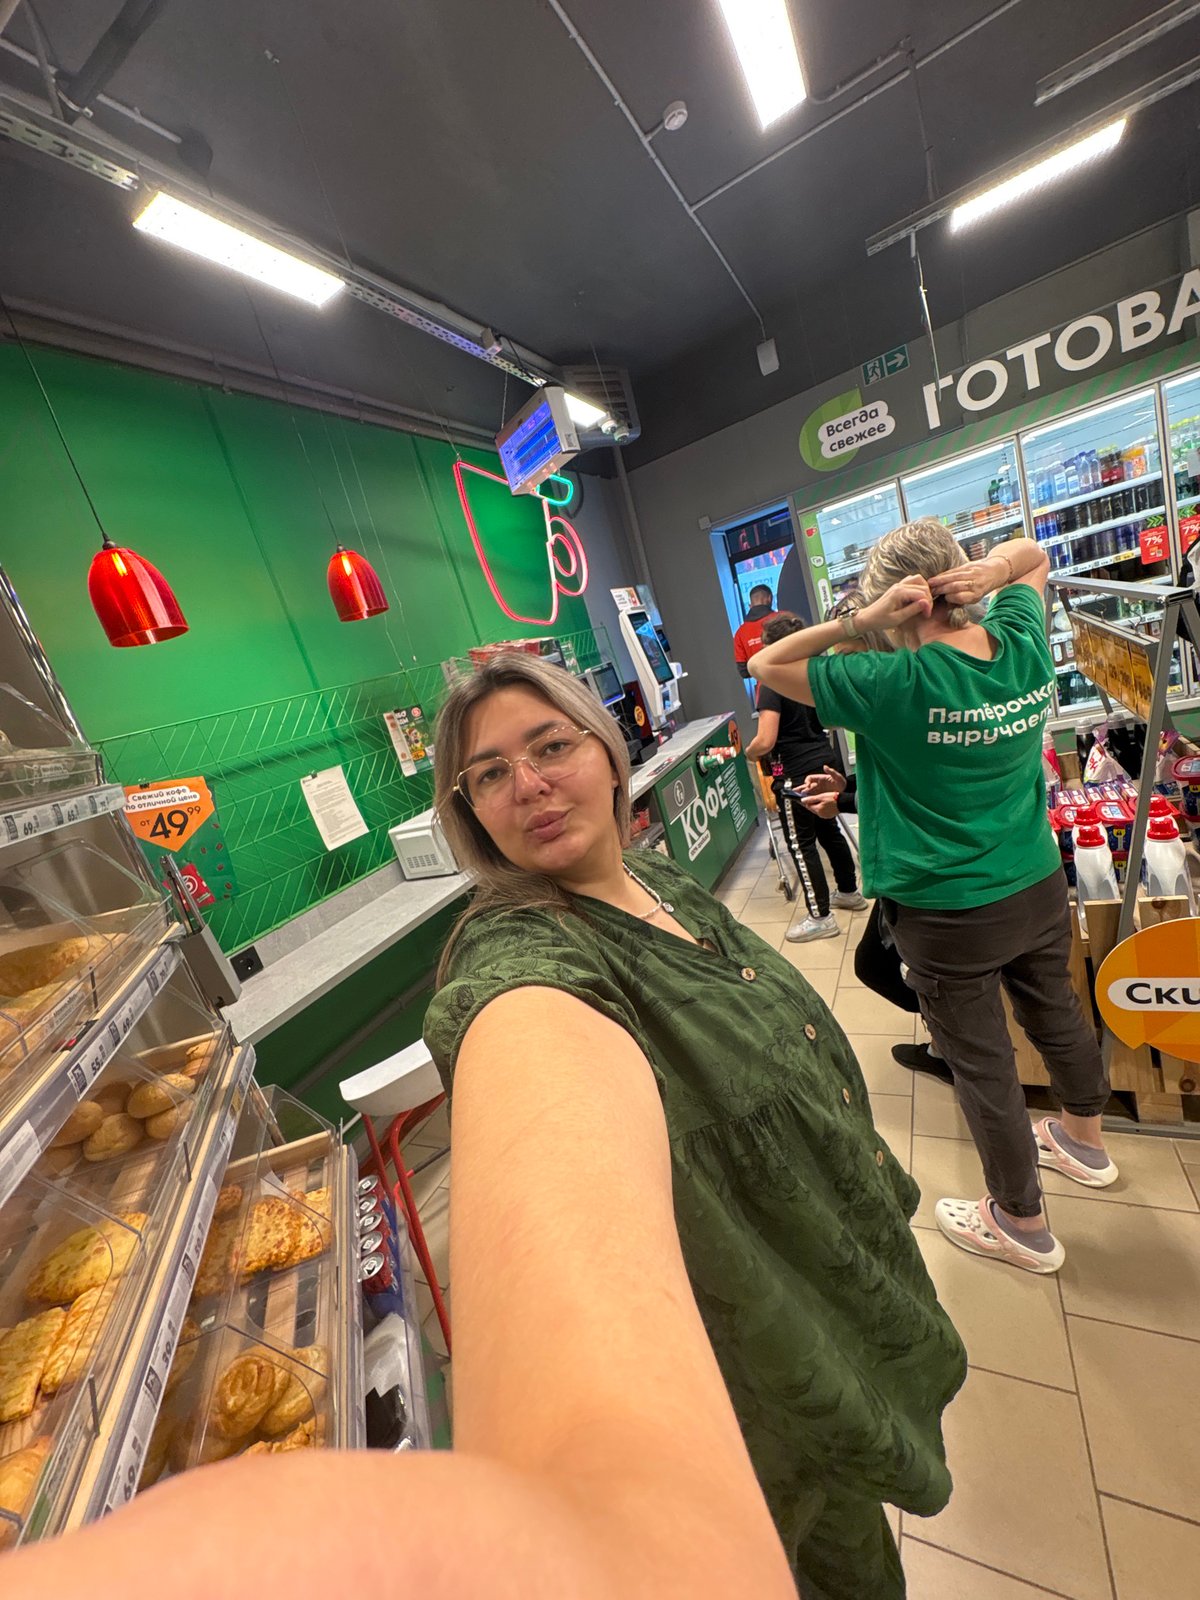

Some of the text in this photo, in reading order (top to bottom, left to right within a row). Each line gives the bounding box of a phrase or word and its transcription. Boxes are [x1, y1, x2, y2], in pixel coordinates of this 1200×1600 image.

[826, 407, 879, 437] Всегда
[829, 422, 887, 452] свежее
[132, 786, 188, 802] Свежий кофе
[137, 797, 177, 809] отличной
[178, 793, 198, 803] цене
[680, 775, 729, 849] КОФЕ
